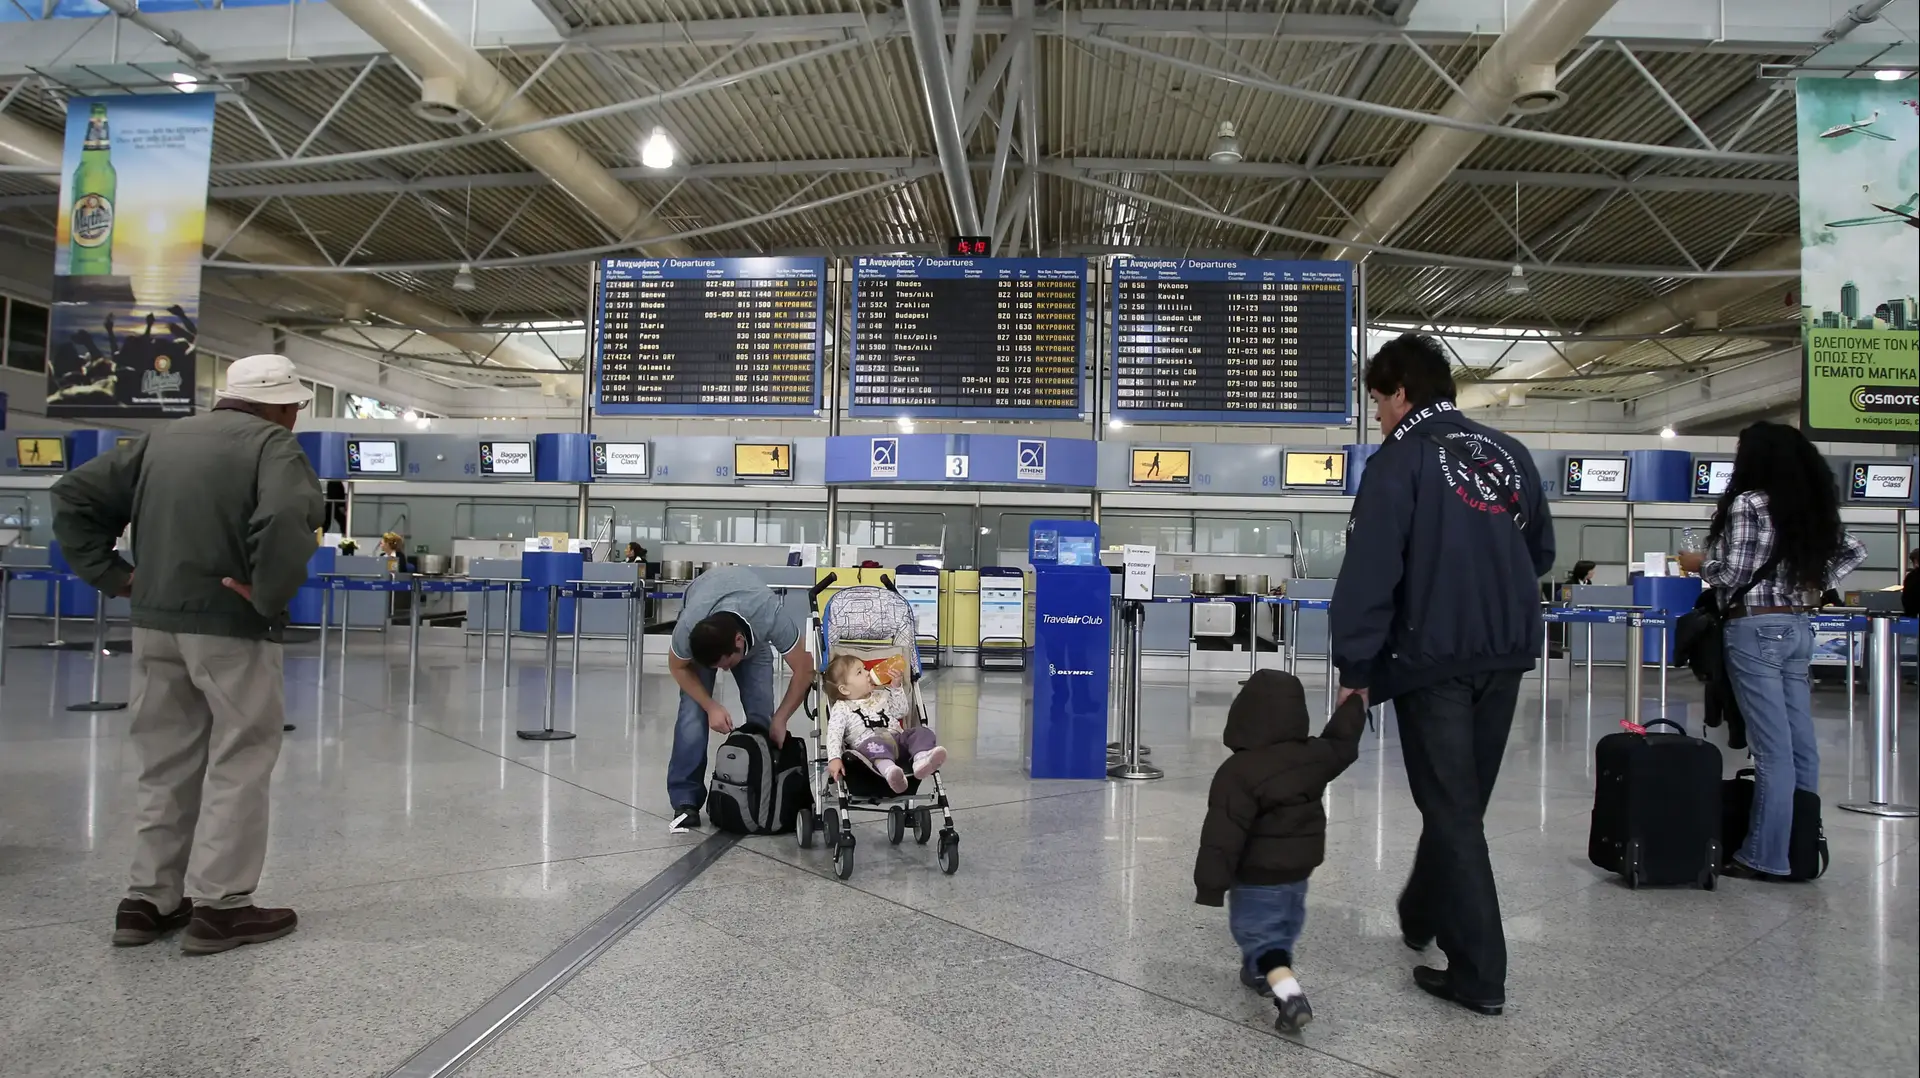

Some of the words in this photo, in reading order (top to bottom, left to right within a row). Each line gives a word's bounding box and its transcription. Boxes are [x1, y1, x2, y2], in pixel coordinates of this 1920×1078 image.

[616, 260, 660, 269] Αναχωρήσεις
[662, 259, 668, 267] /
[670, 260, 715, 269] Departures
[869, 259, 915, 267] Αναχωρήσεις
[918, 258, 923, 266] /
[926, 258, 974, 267] Departures
[1130, 260, 1177, 269] Αναχωρήσεις
[1180, 260, 1185, 268] /
[1188, 260, 1236, 269] Departures
[1814, 336, 1880, 349] ΒΛΕΠΟΥΜΕ
[1884, 339, 1907, 350] ΤΟΝ
[1814, 351, 1848, 363] ΟΠΩΣ
[1852, 352, 1876, 364] ΕΣΥ.
[1815, 366, 1864, 378] ΓΕΜΑΤΟ
[1869, 368, 1917, 379] ΜΑΓΙΚΑ
[1858, 394, 1919, 405] COSMOTE
[1394, 408, 1434, 440] BLUE
[1863, 416, 1892, 425] κόσμος
[656, 465, 668, 476] 94
[716, 466, 728, 476] 93
[953, 457, 963, 476] 3
[1262, 475, 1275, 486] 89
[1456, 486, 1488, 511] BLUE
